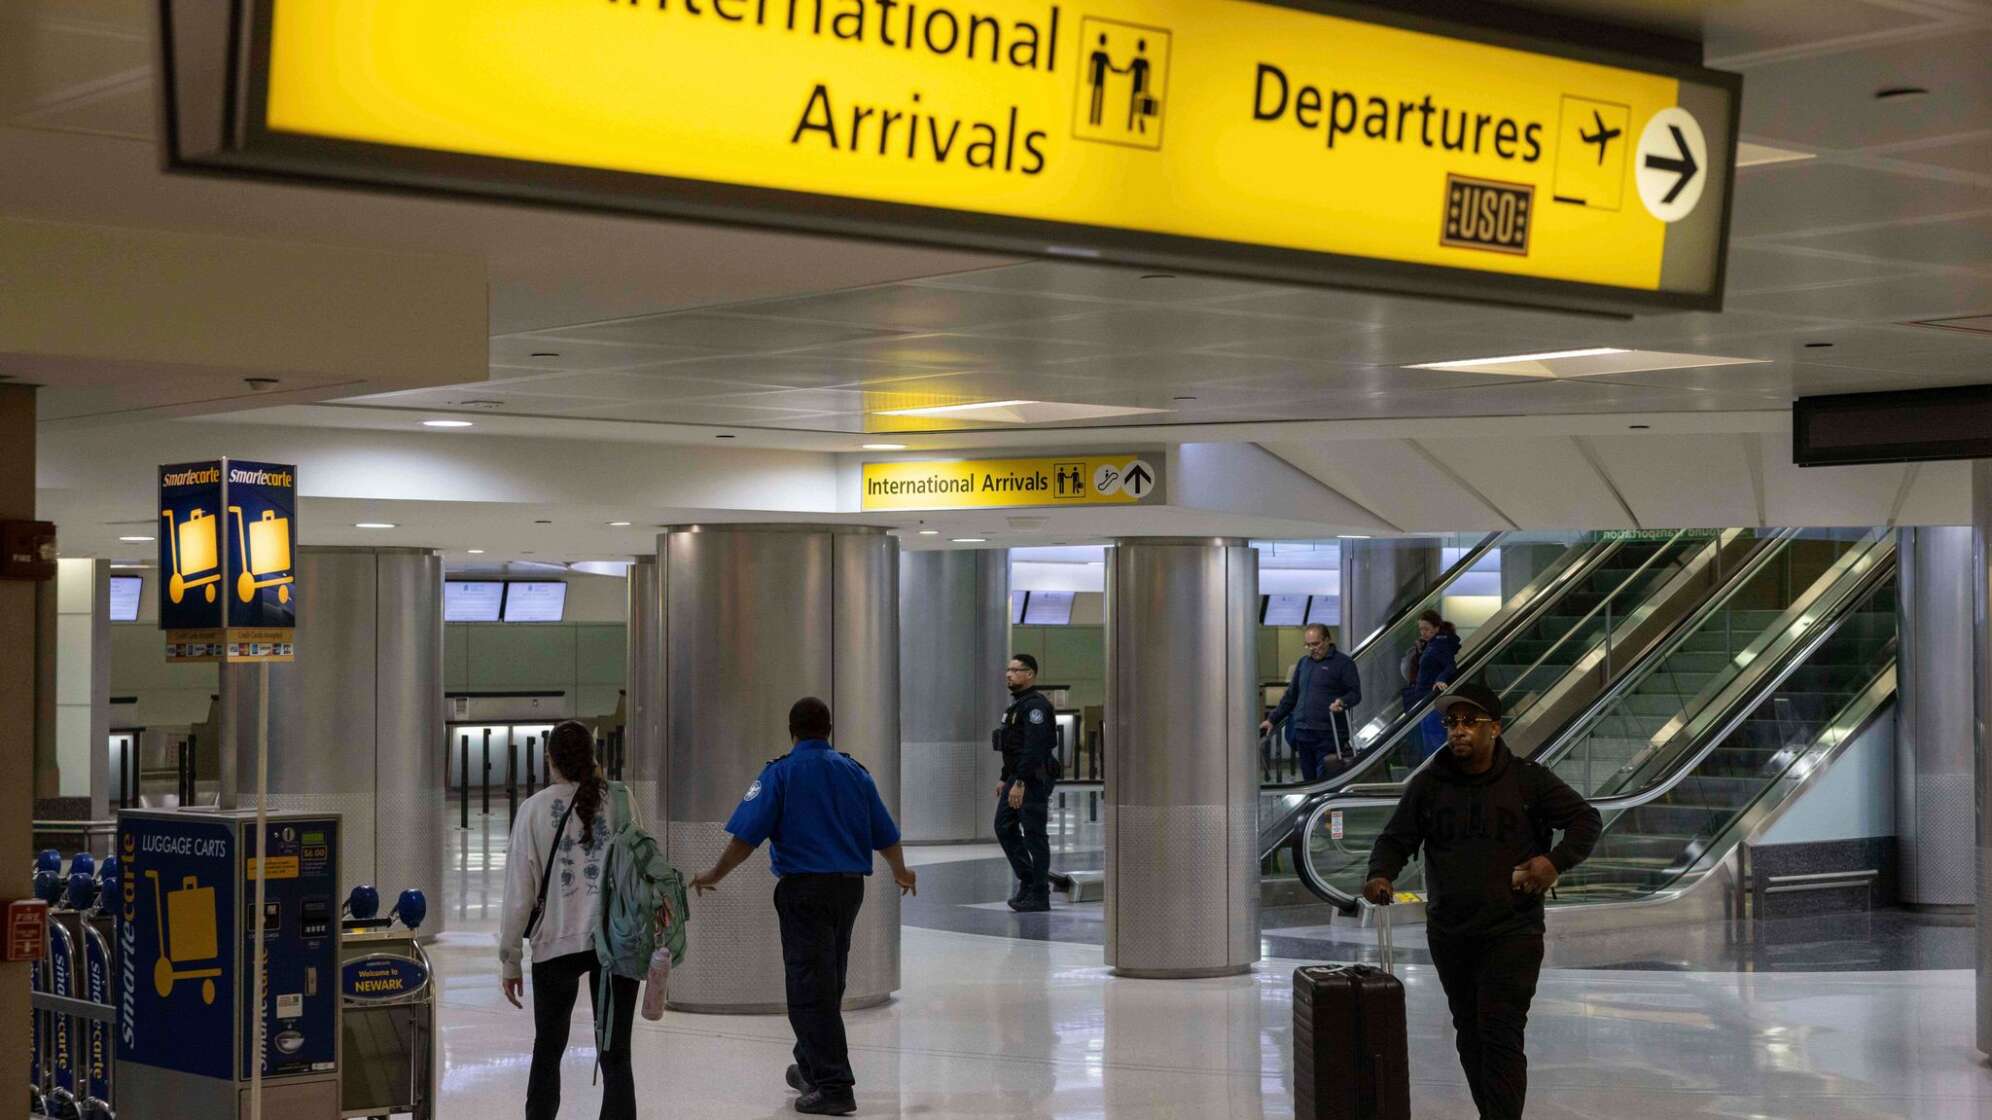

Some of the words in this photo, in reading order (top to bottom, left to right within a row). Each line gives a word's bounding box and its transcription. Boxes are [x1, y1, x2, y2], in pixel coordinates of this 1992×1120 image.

[789, 84, 1048, 176] Arrivals
[1253, 62, 1543, 163] Departures
[1458, 186, 1515, 243] USO
[868, 473, 974, 495] International
[982, 471, 1049, 492] Arrivals
[142, 835, 192, 855] LUGGAGE
[194, 838, 226, 858] CARTS
[354, 978, 403, 992] NEWARK
